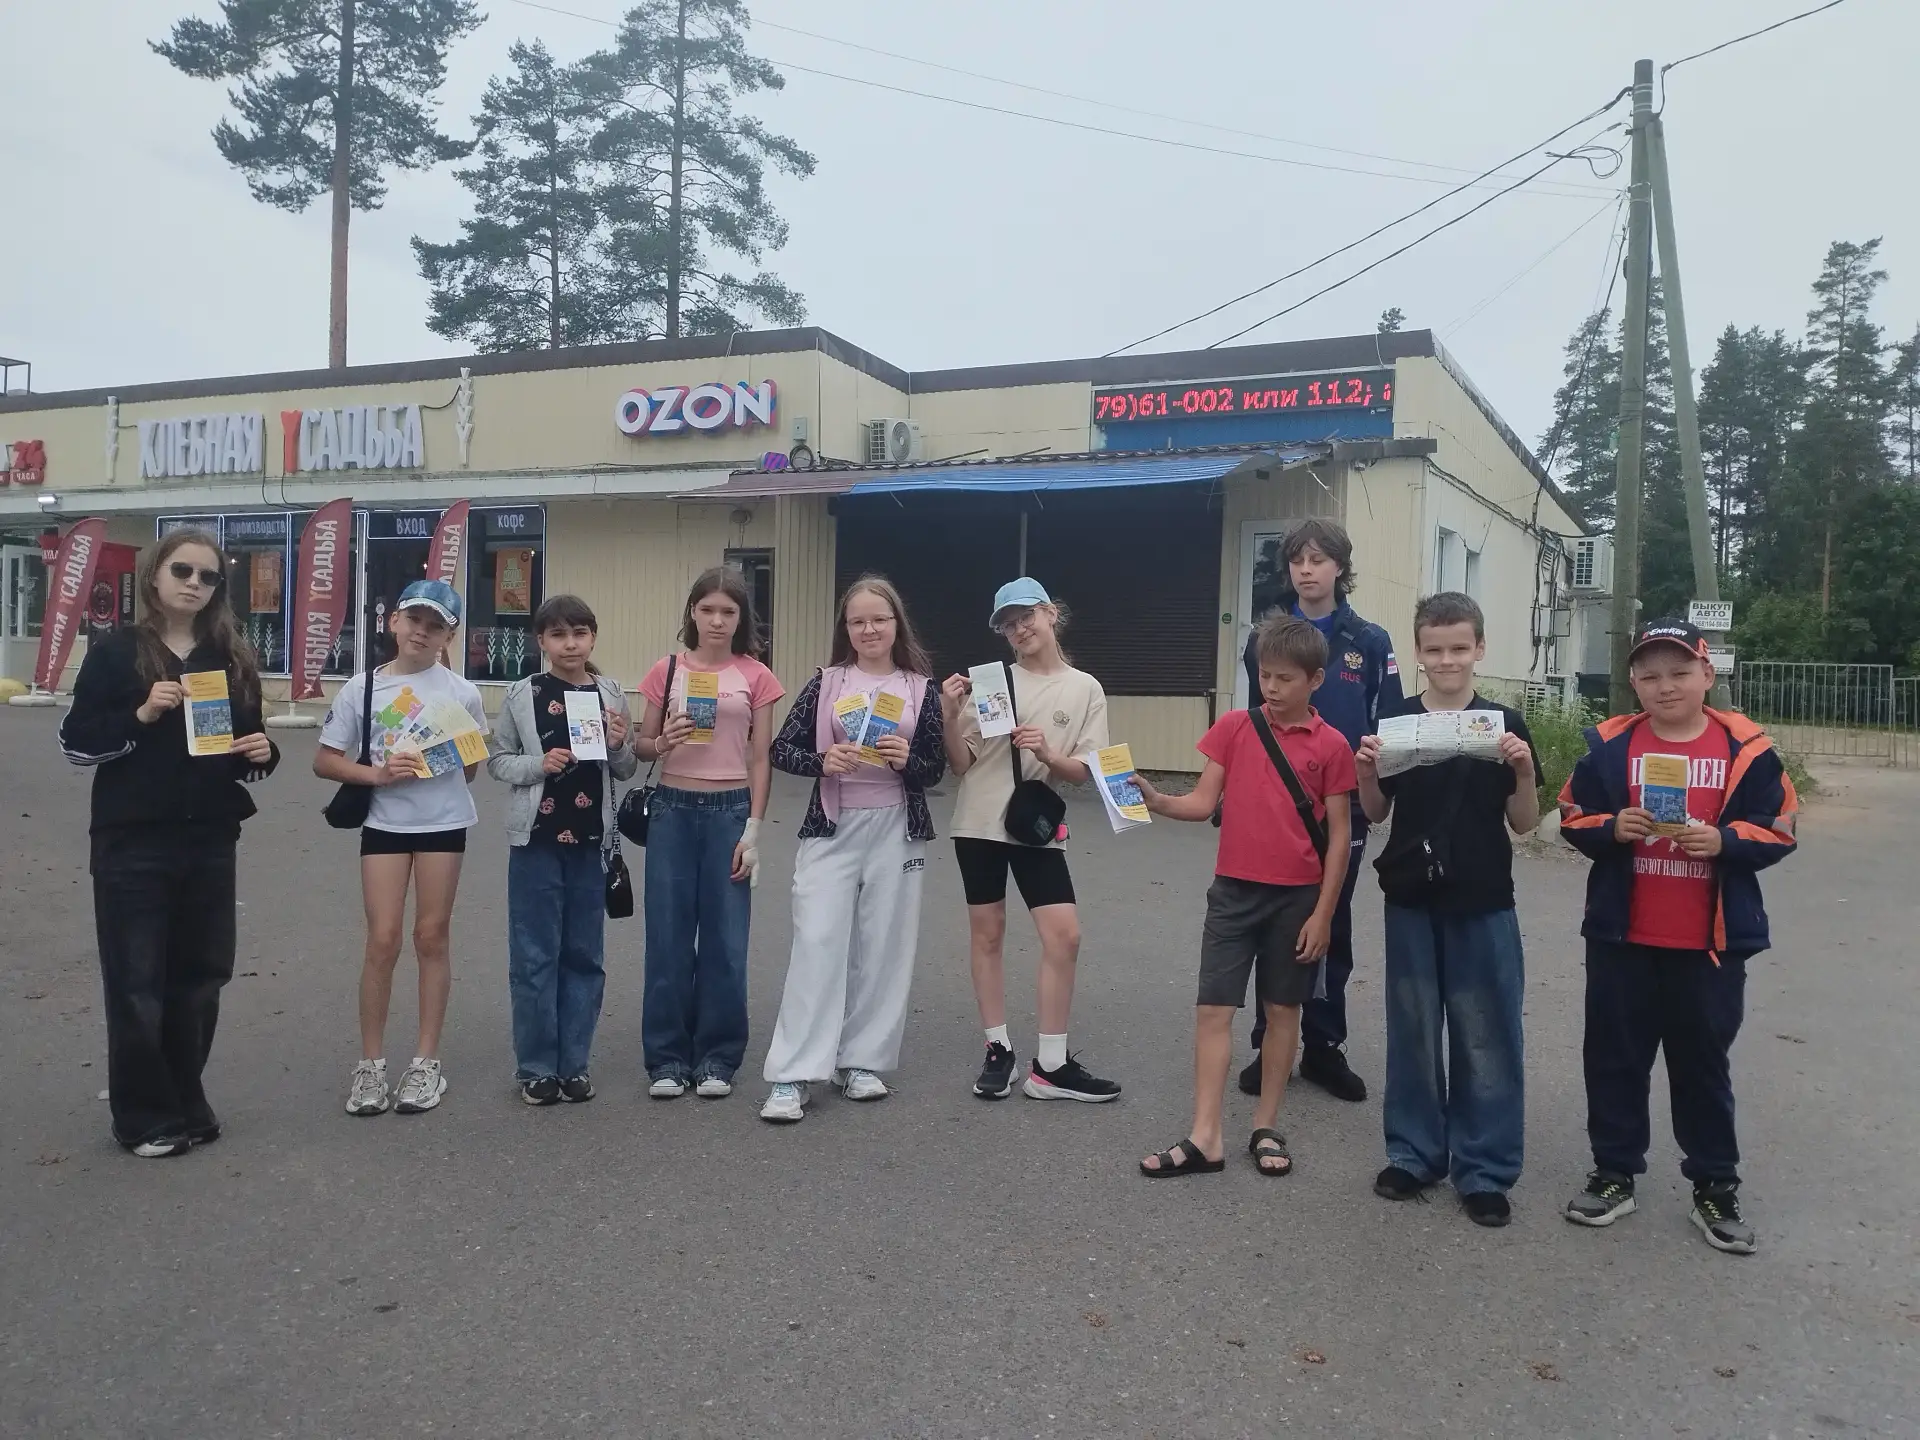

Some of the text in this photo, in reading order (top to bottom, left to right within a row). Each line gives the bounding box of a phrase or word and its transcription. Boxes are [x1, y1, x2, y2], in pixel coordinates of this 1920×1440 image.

[615, 379, 777, 438] OZON
[1096, 388, 1234, 420] 79)61-002
[1243, 389, 1300, 410] или
[138, 404, 424, 478] ХЛЕБНАЯ УСАДЬБА
[16, 471, 36, 480] ЧАСА
[497, 513, 525, 534] кофе
[309, 520, 338, 602] УСАДЬБА
[1692, 602, 1731, 611] ВЫКУП
[1663, 859, 1688, 877] НАШИ
